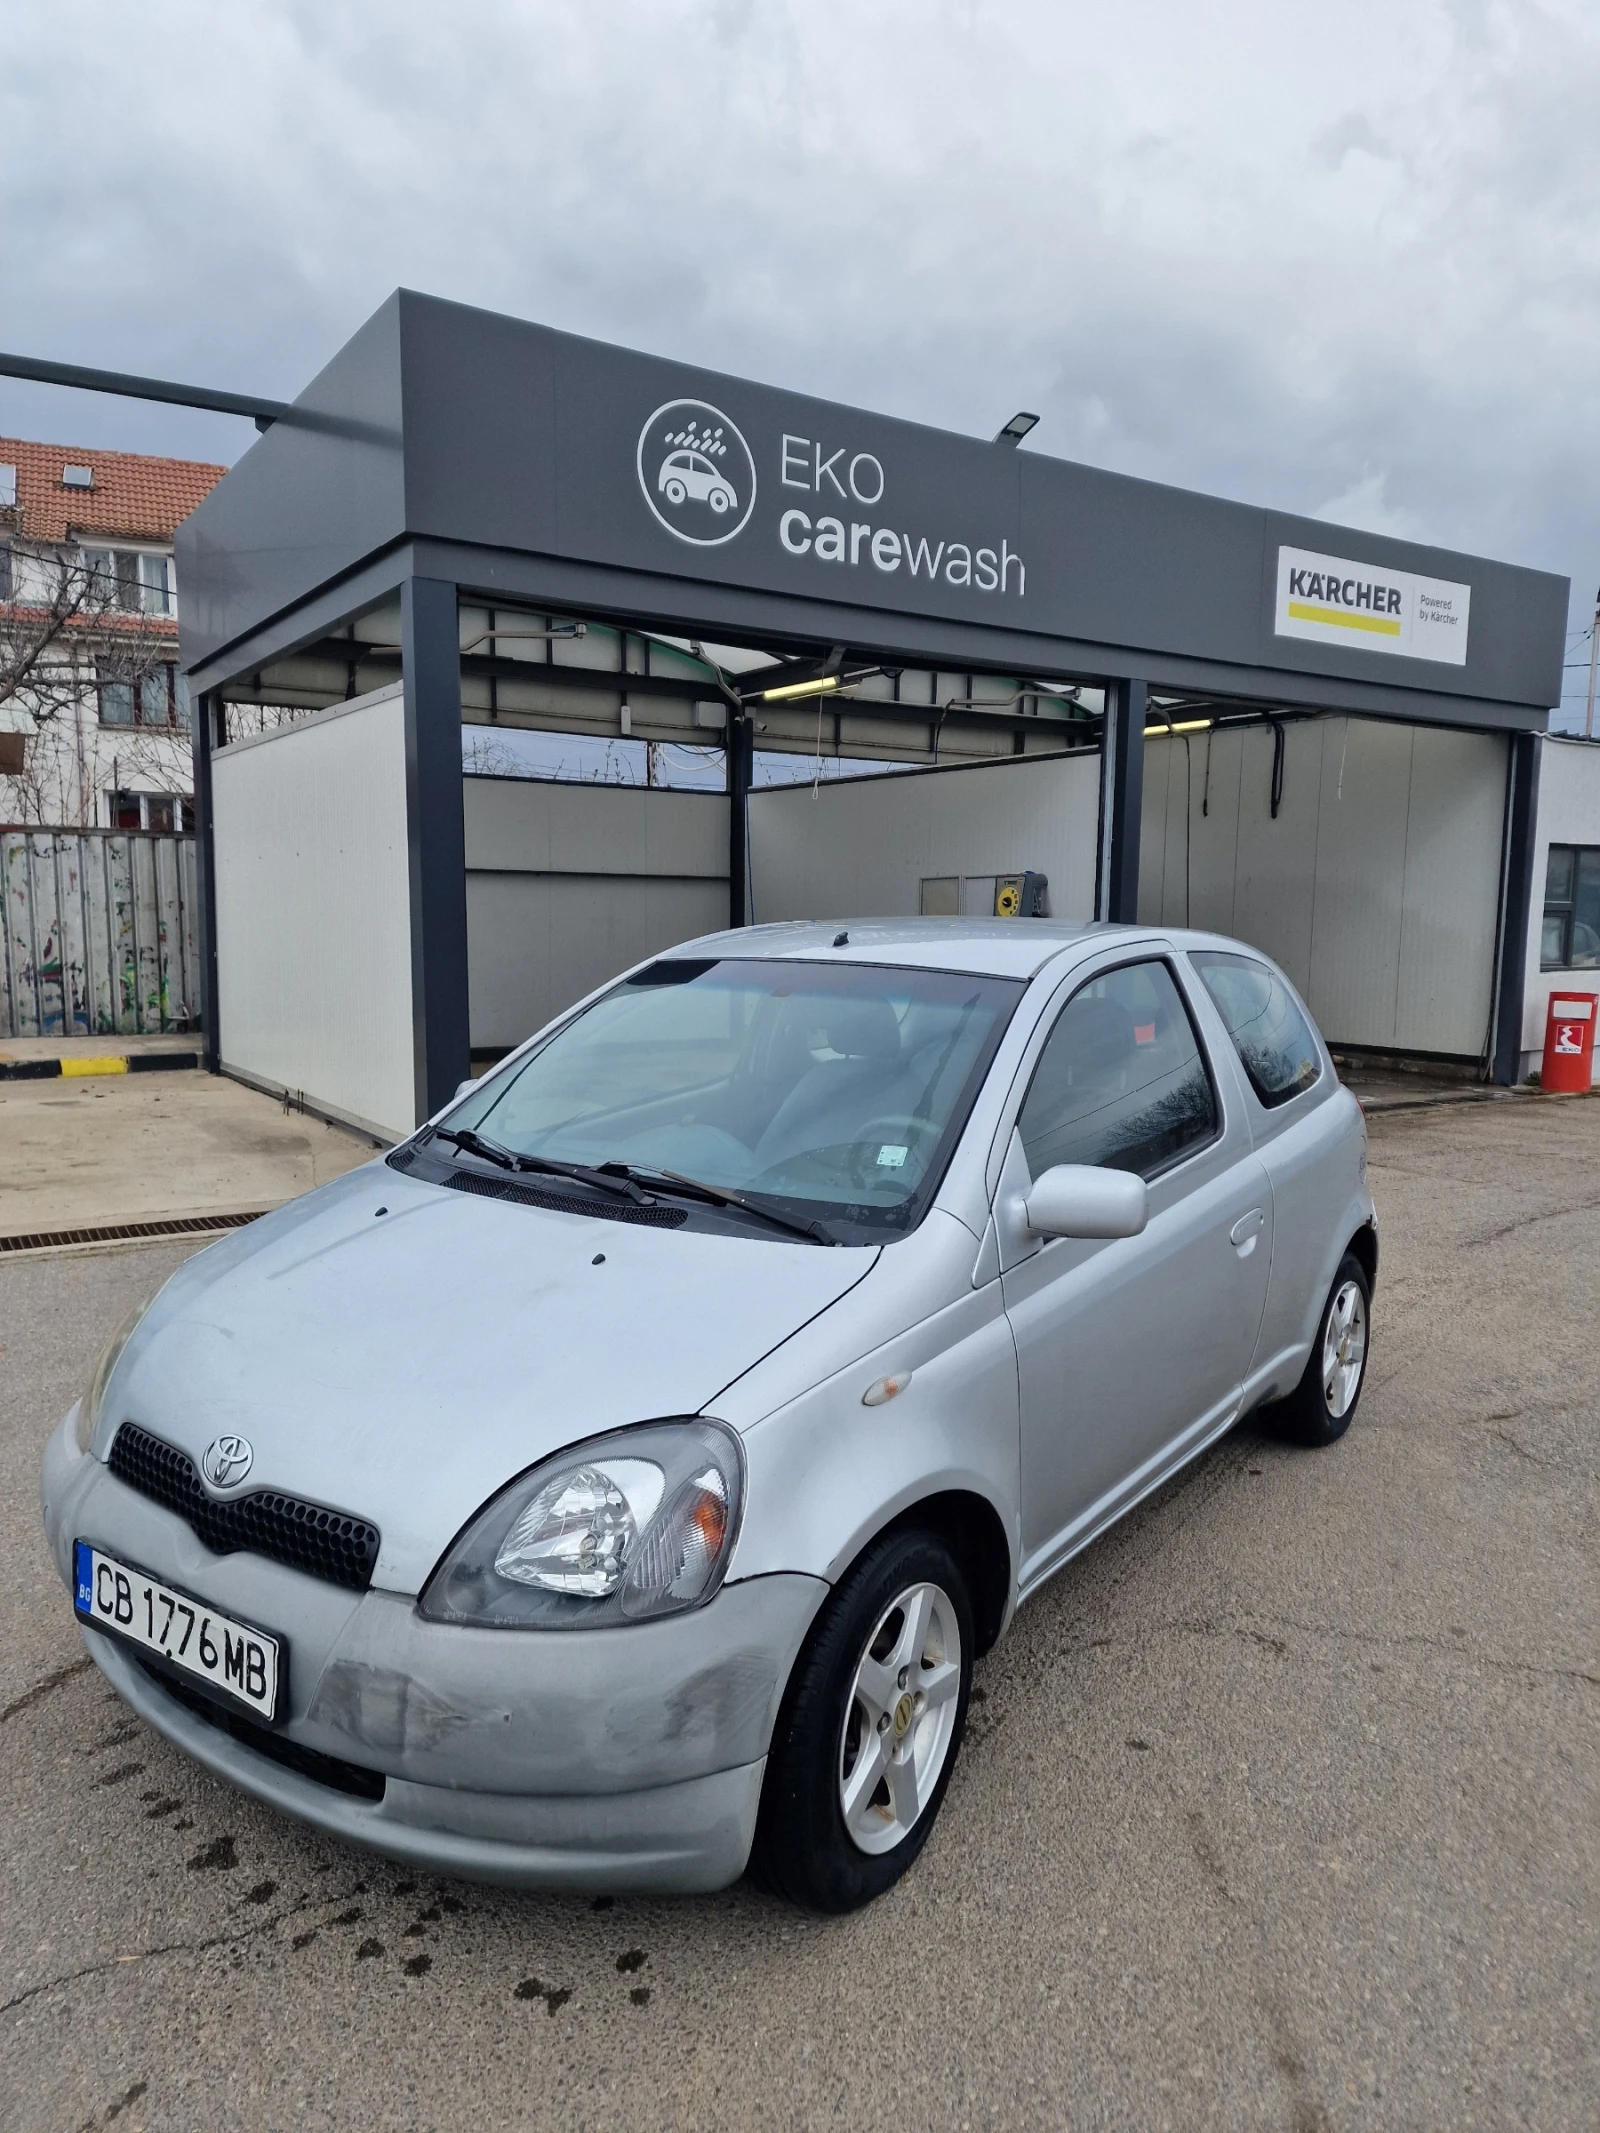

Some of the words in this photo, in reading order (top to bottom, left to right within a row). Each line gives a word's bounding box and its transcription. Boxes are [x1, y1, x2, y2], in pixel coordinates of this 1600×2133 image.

[780, 432, 885, 504] EKO
[779, 508, 1026, 596] carewash
[1289, 567, 1402, 615] KÄRCHER
[1420, 594, 1452, 610] Powered
[1419, 609, 1429, 622] by
[1430, 610, 1459, 625] Kärcher
[79, 1583, 91, 1602] BG
[97, 1562, 134, 1625] CB
